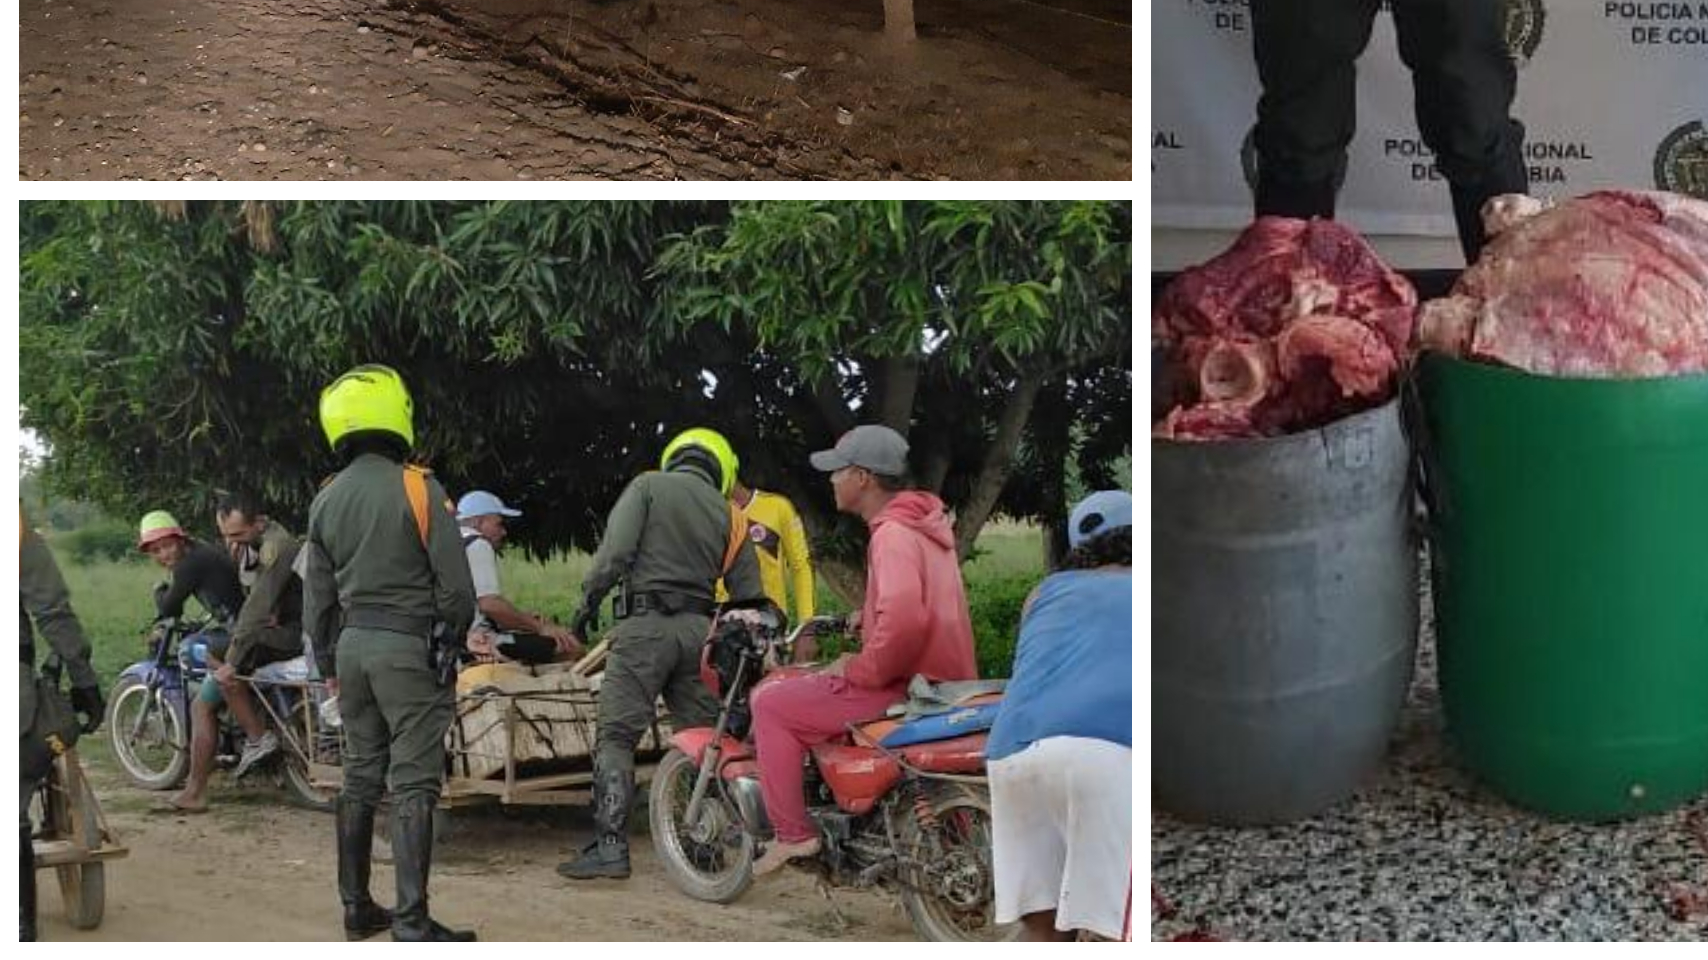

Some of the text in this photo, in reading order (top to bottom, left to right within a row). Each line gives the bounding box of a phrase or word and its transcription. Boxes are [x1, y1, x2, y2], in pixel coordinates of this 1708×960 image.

[1605, 1, 1692, 20] POLICIA
[1216, 12, 1244, 31] DE
[1632, 27, 1662, 44] DE
[1526, 142, 1592, 160] IONAL
